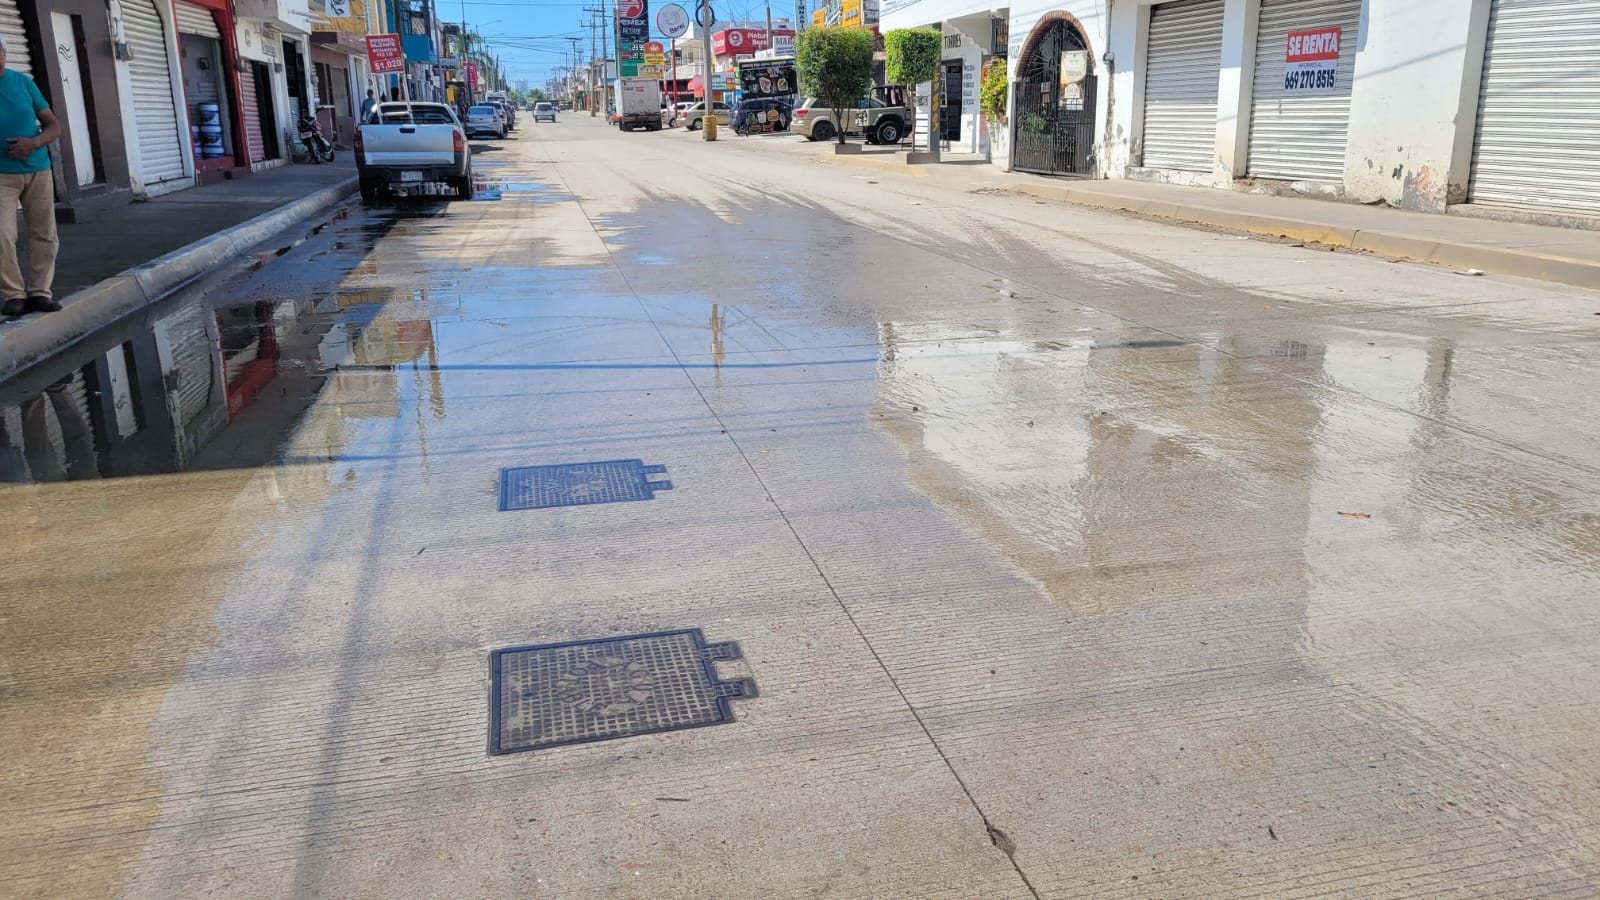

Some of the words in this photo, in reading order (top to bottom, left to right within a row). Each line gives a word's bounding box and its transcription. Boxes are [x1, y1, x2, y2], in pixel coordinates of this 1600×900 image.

[669, 23, 686, 34] Berel
[944, 34, 962, 49] TORRES
[1288, 36, 1302, 56] SE
[1302, 32, 1338, 54] RENTA
[375, 59, 402, 71] $1,020
[1284, 70, 1300, 90] 669
[1300, 70, 1315, 88] 270
[1316, 69, 1336, 88] 8515
